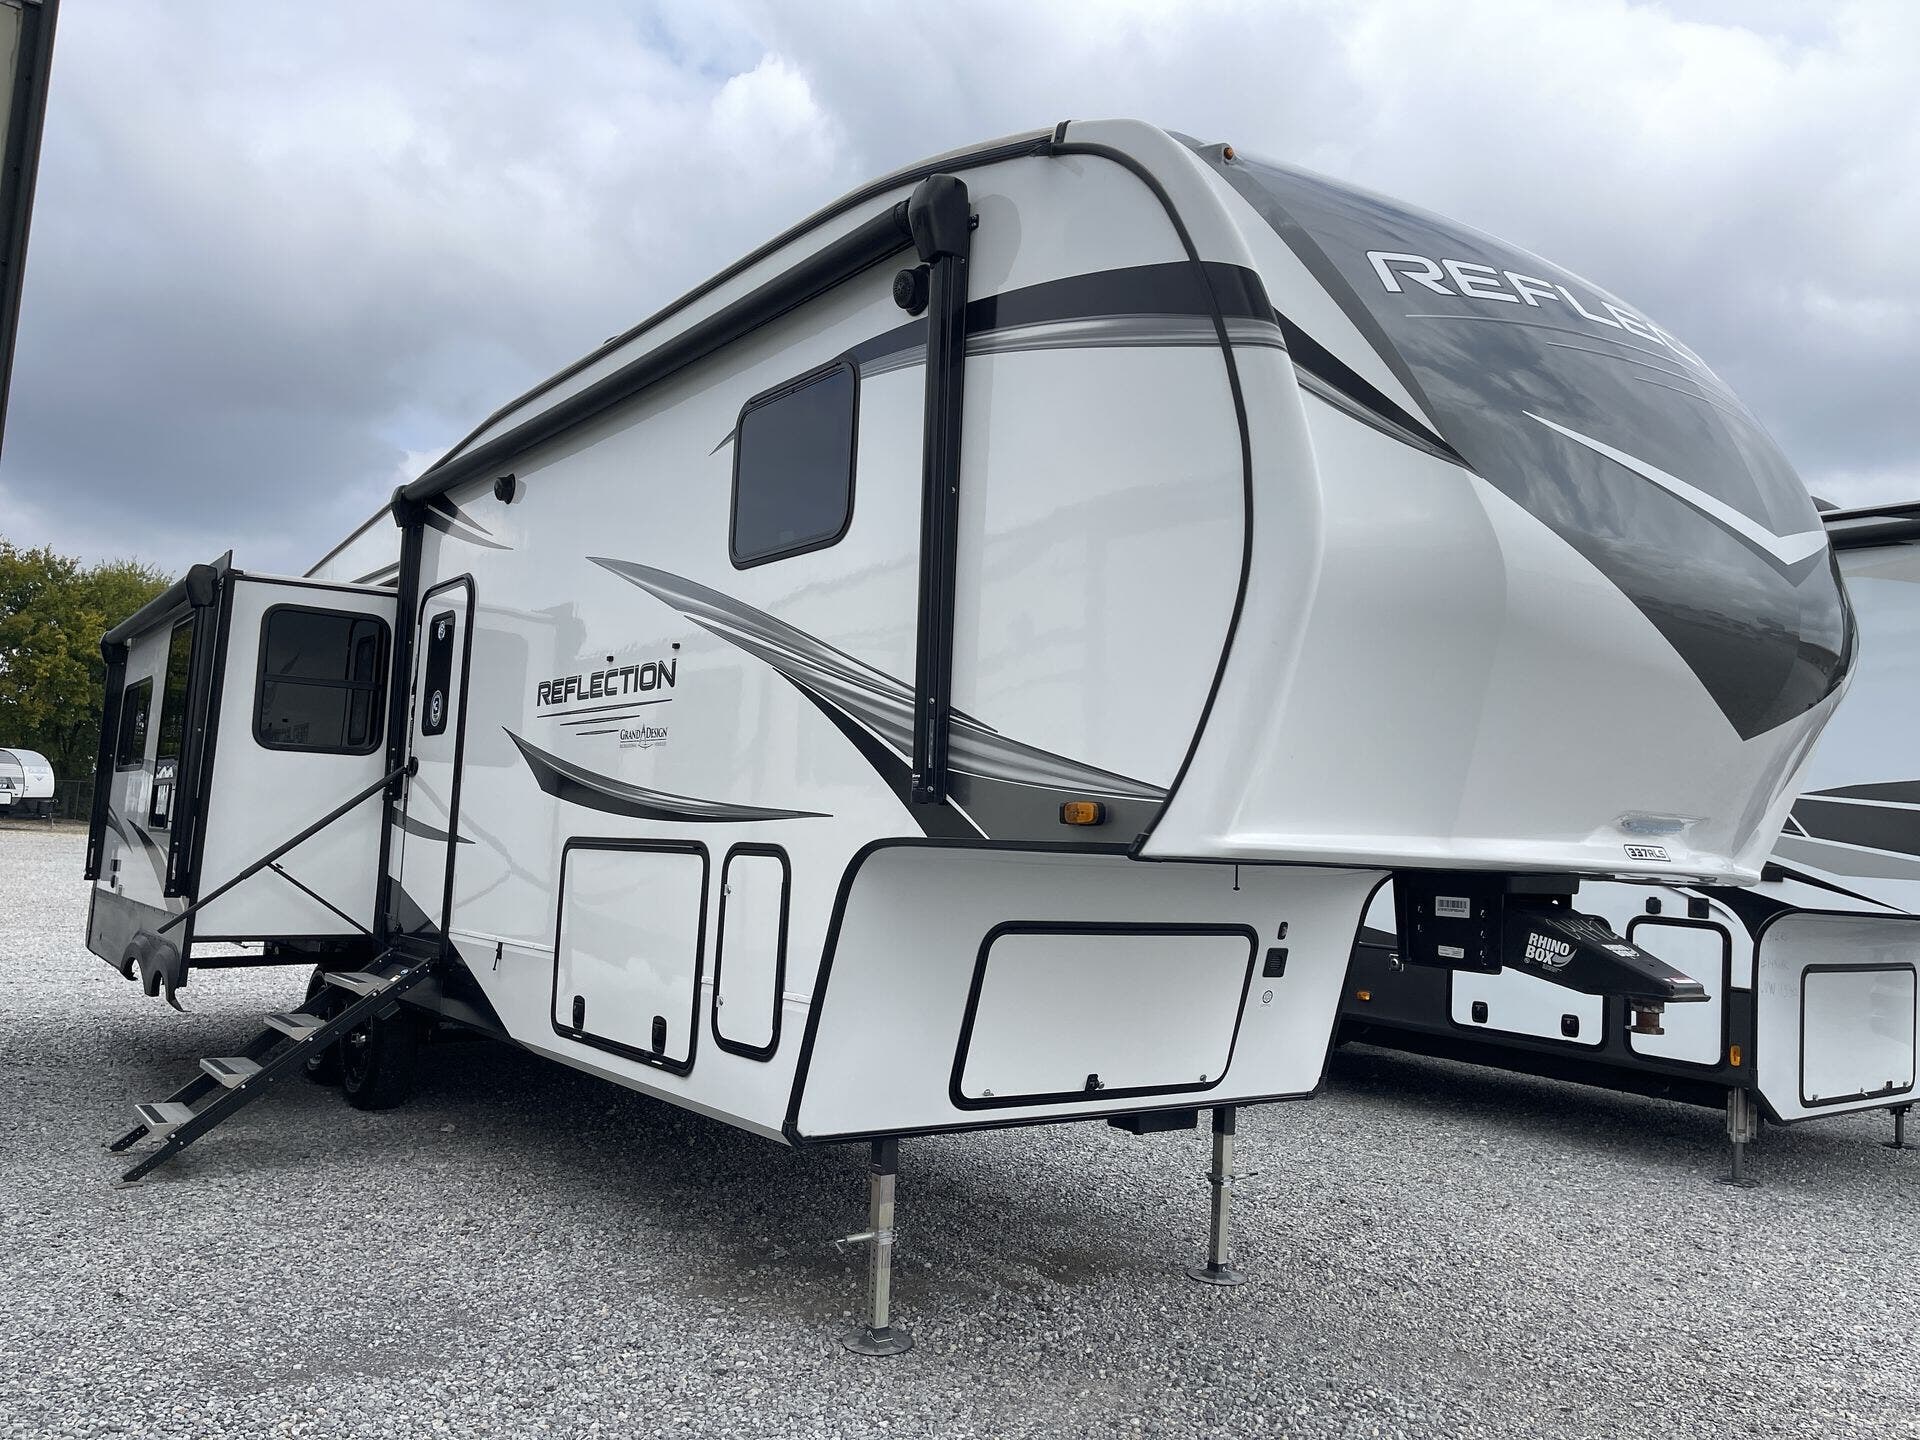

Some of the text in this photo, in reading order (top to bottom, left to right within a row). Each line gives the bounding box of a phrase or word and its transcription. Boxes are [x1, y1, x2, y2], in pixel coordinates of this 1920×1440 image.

[537, 658, 677, 707] REFLECTION
[1627, 847, 1667, 859] 337RLS
[1525, 944, 1553, 965] BOX
[1528, 932, 1570, 956] RHINO
